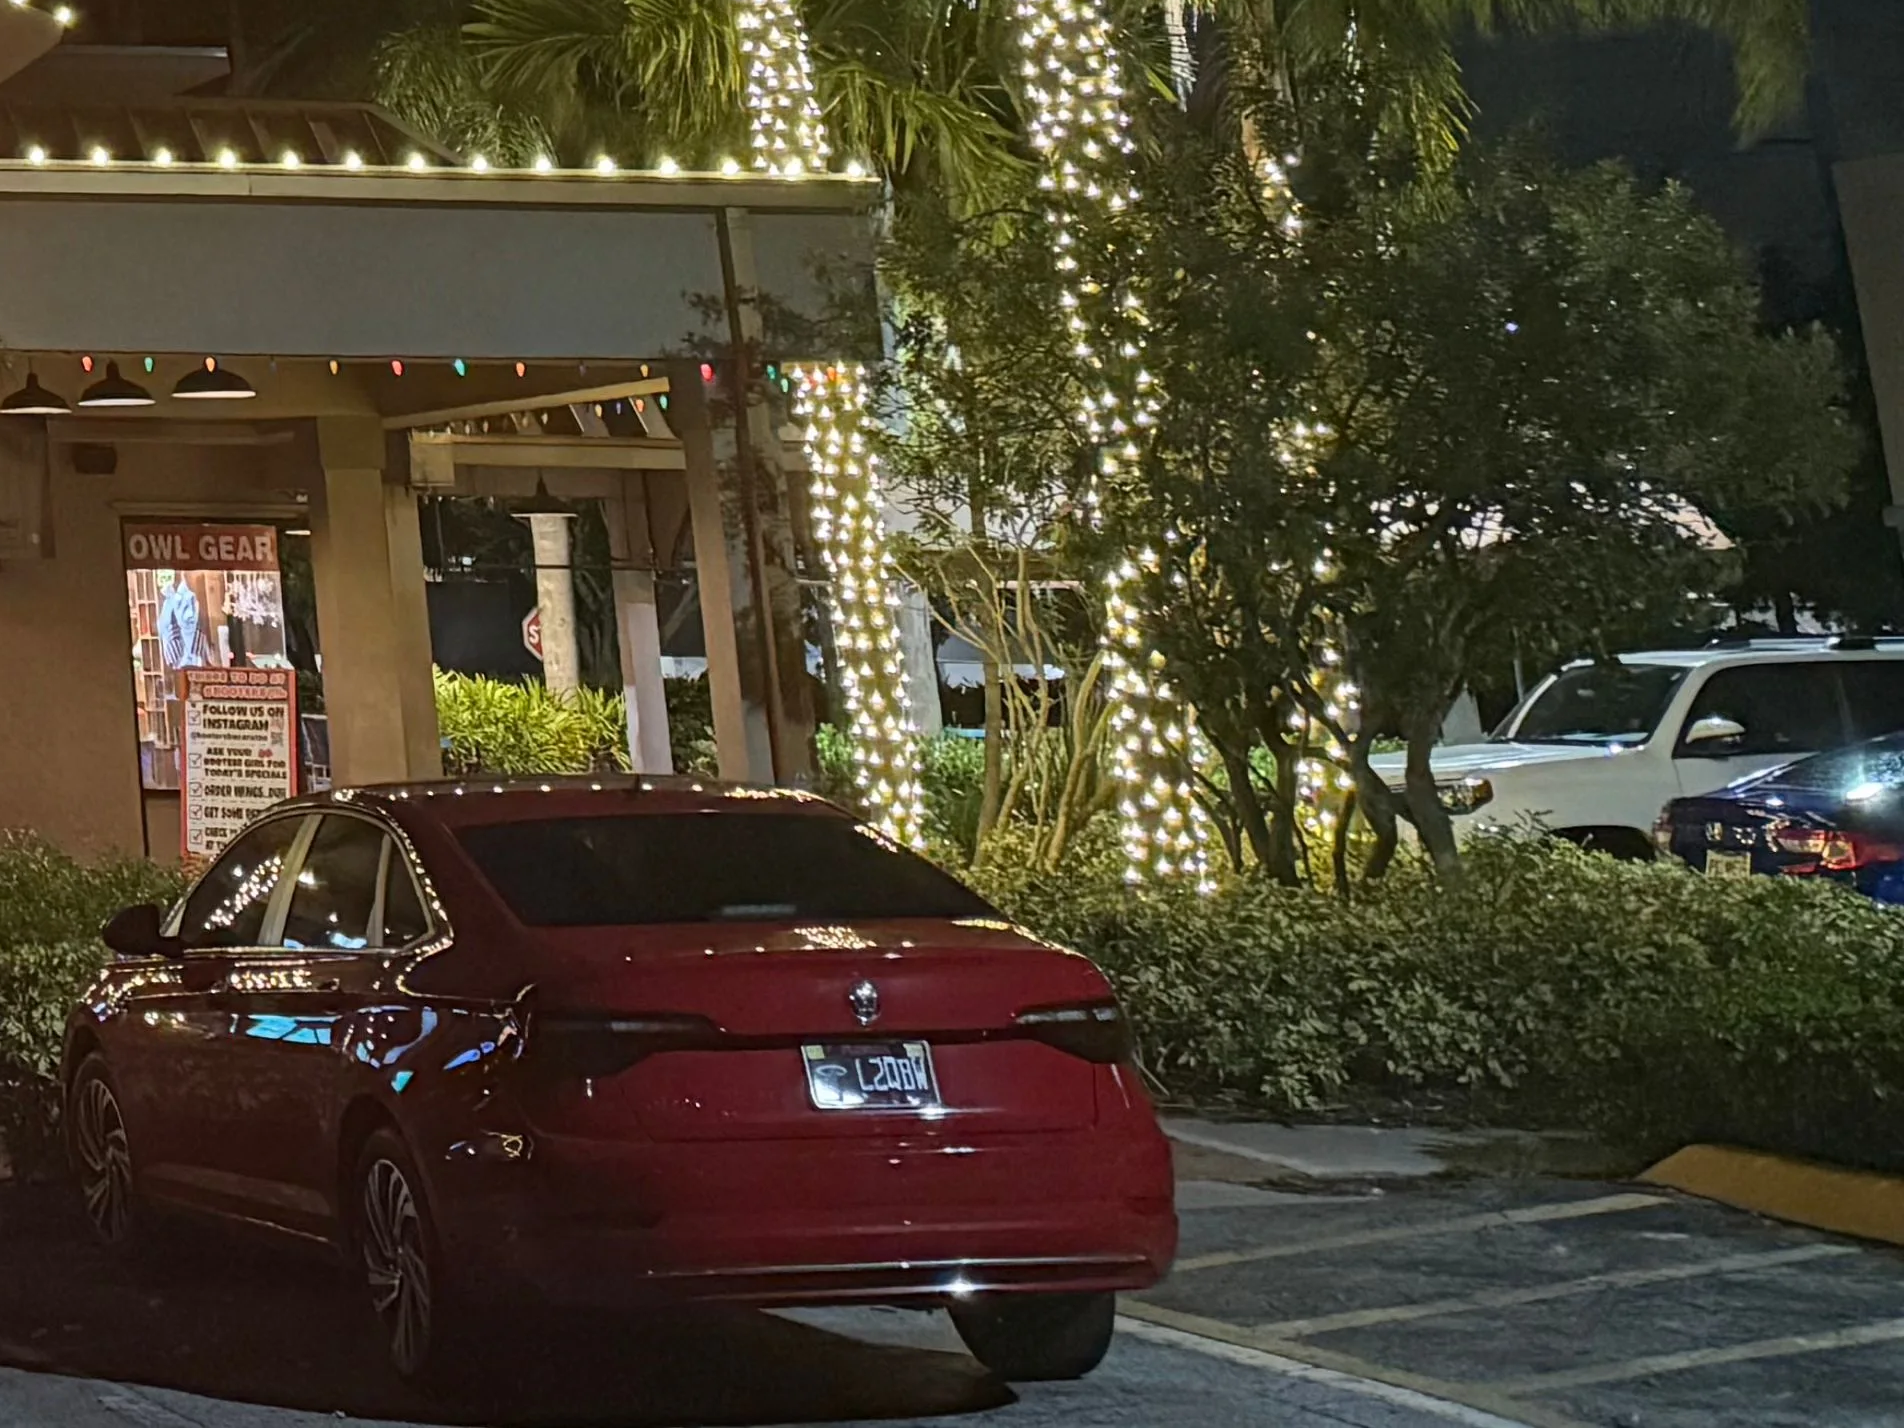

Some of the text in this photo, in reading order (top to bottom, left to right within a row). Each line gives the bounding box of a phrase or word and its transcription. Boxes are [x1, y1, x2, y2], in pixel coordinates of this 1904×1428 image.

[129, 534, 274, 562] OWL GEAR
[202, 704, 285, 717] FOLLOW US ON
[203, 719, 269, 731] INSTAGRAM
[204, 785, 232, 797] ORDER
